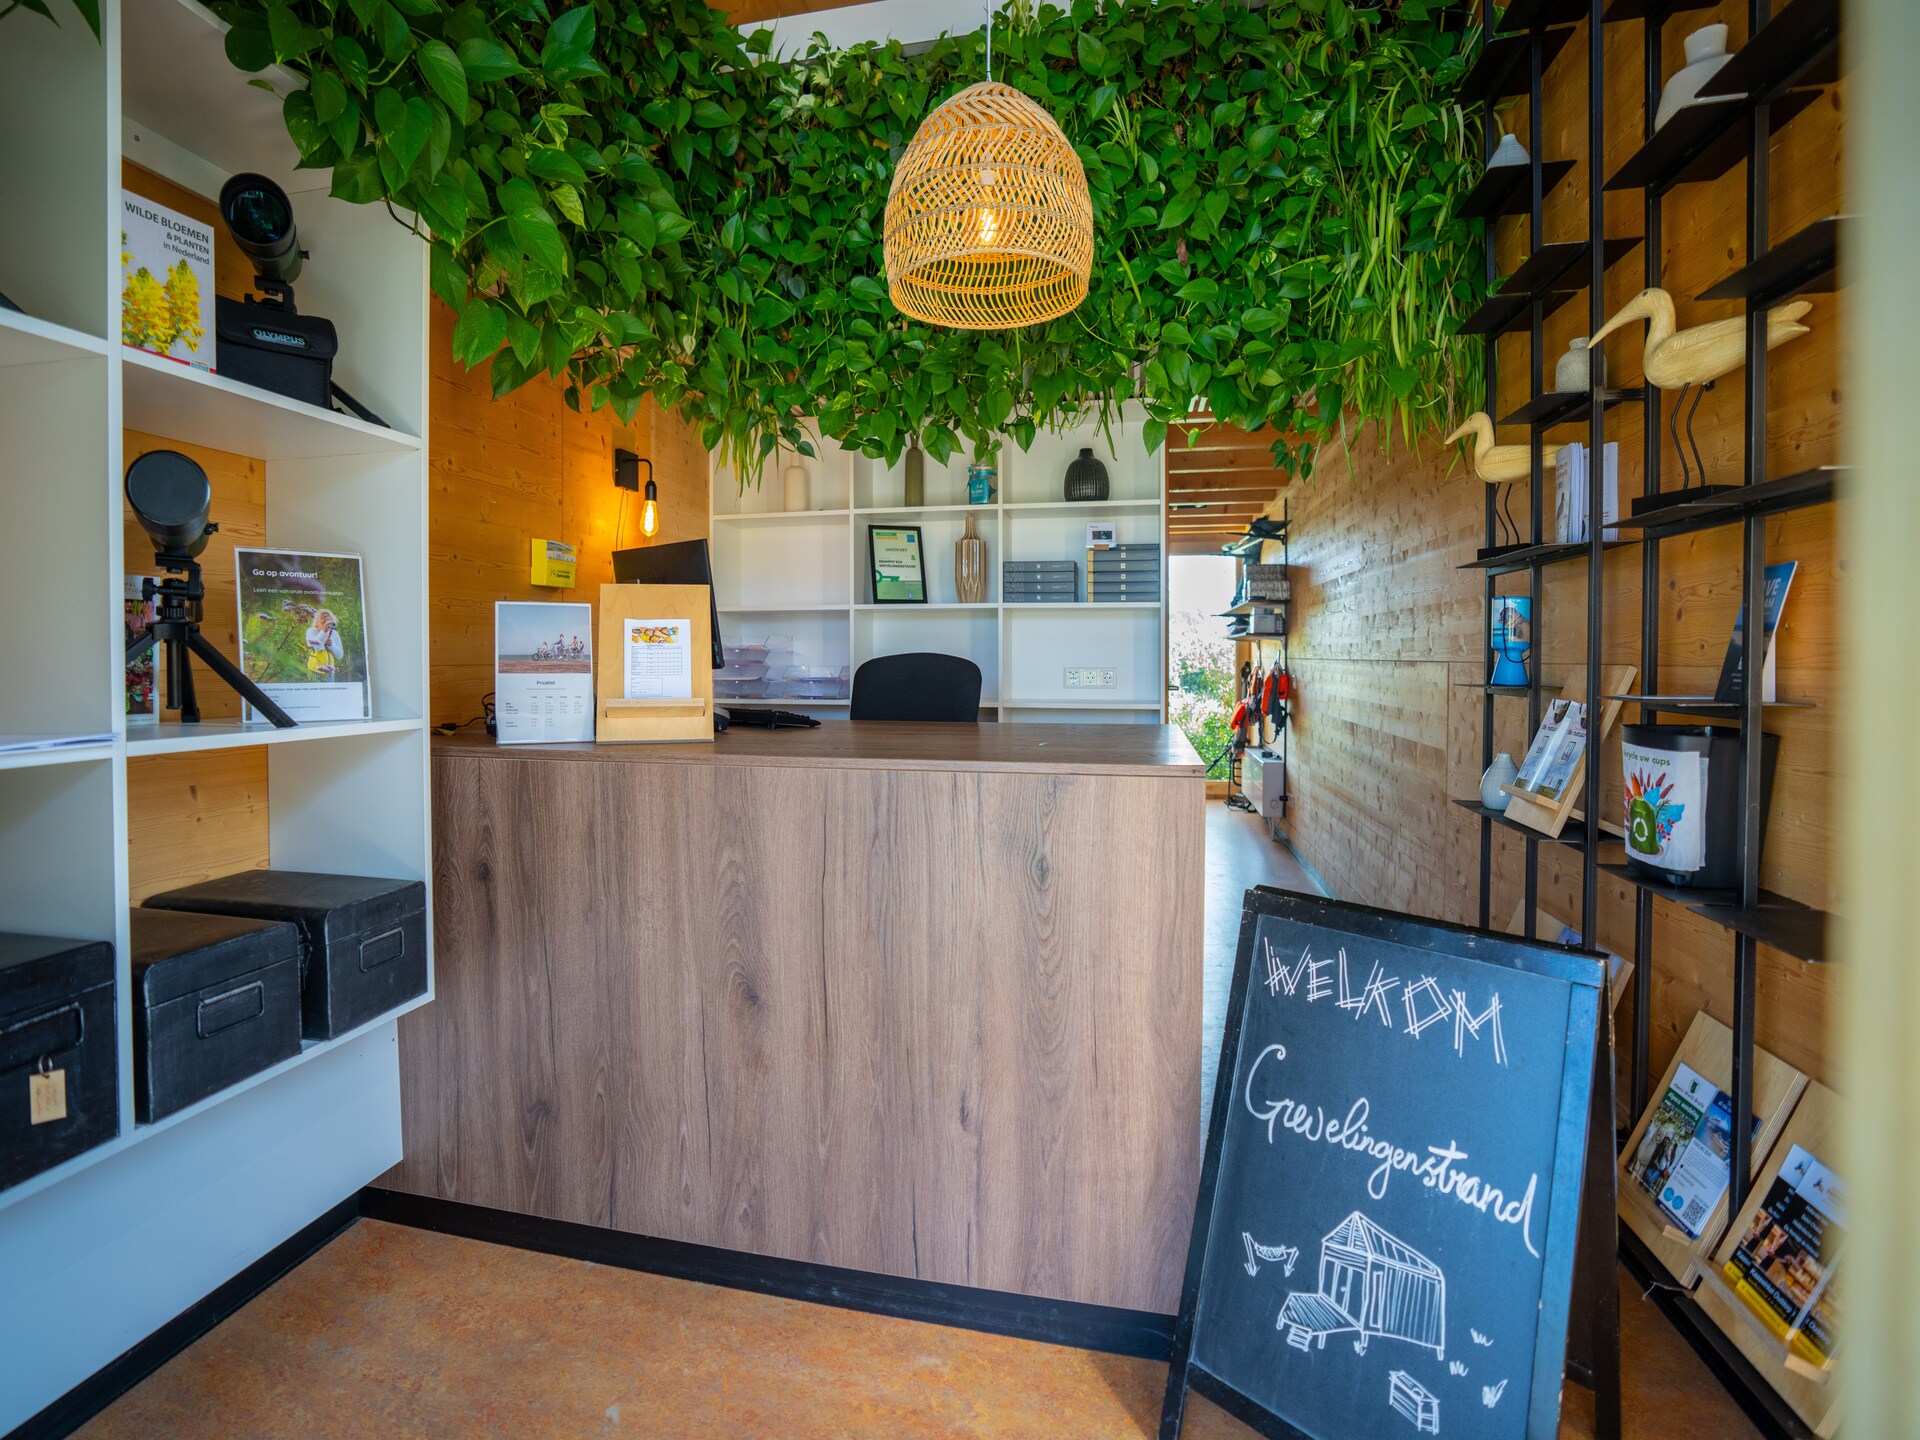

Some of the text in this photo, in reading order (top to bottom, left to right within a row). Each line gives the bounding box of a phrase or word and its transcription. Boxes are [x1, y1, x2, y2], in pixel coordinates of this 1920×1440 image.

[125, 201, 209, 244] WILDE BLOEMEN
[163, 241, 210, 265] in Nederland
[166, 232, 210, 255] & PLANTEN
[253, 329, 306, 346] OLYMPUS
[252, 568, 318, 579] Ga op avontuur!
[1652, 757, 1671, 767] cups
[1264, 937, 1508, 1068] WELKOM
[1245, 1044, 1540, 1259] Grevelingenstrand
